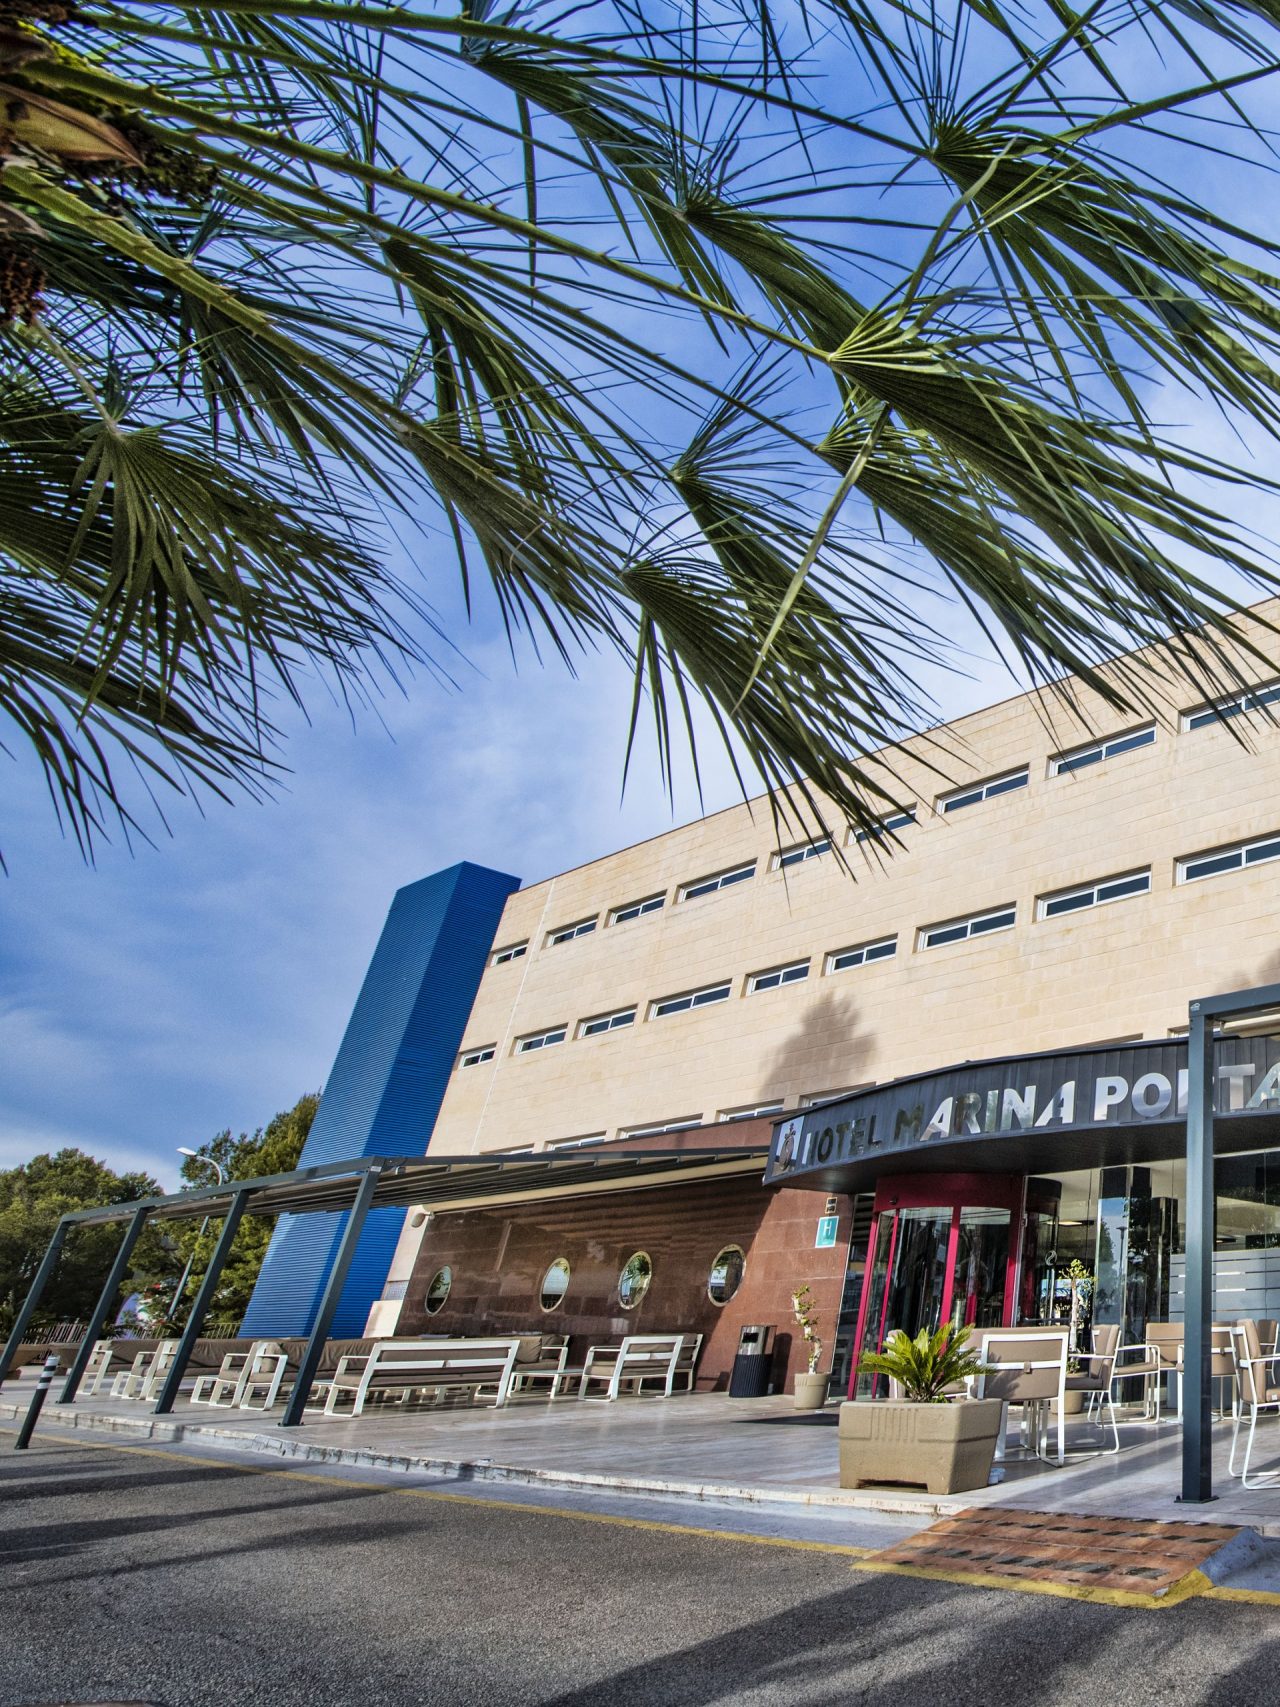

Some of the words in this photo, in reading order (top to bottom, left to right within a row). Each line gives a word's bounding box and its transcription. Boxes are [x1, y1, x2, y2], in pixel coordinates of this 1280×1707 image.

[801, 1115, 882, 1166] HOTEL
[893, 1080, 1076, 1142] MARINA
[822, 1220, 832, 1236] H
